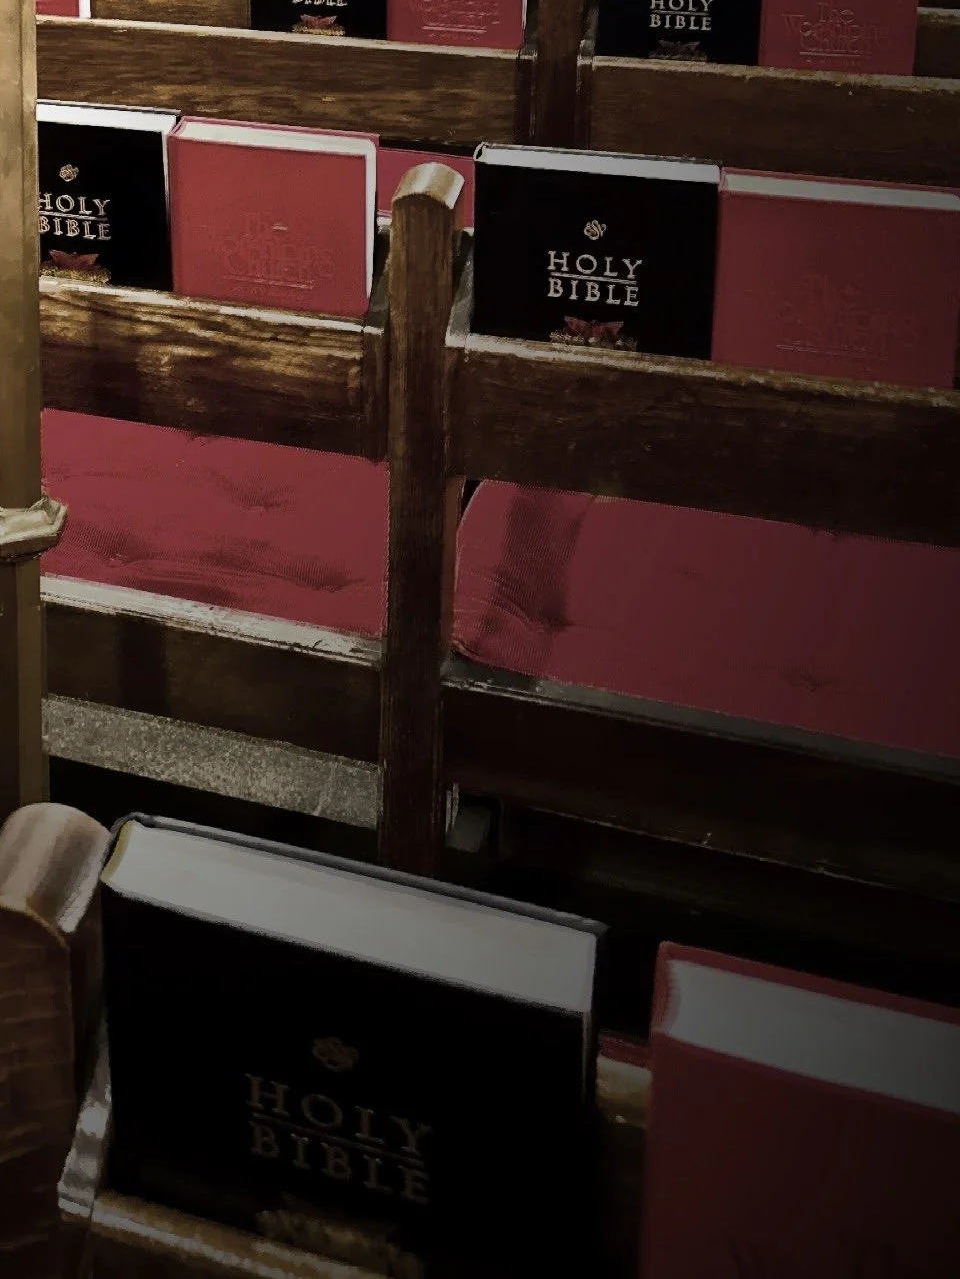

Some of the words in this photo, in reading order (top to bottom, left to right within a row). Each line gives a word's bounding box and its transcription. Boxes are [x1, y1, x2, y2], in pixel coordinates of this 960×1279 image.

[649, 13, 713, 31] BIBLE
[37, 192, 111, 217] HOLY
[37, 215, 112, 241] BIBLE
[546, 250, 644, 279] HOLY
[546, 276, 641, 307] BIBLE
[243, 1072, 439, 1158] HOLY
[249, 1120, 432, 1207] BIBLE
